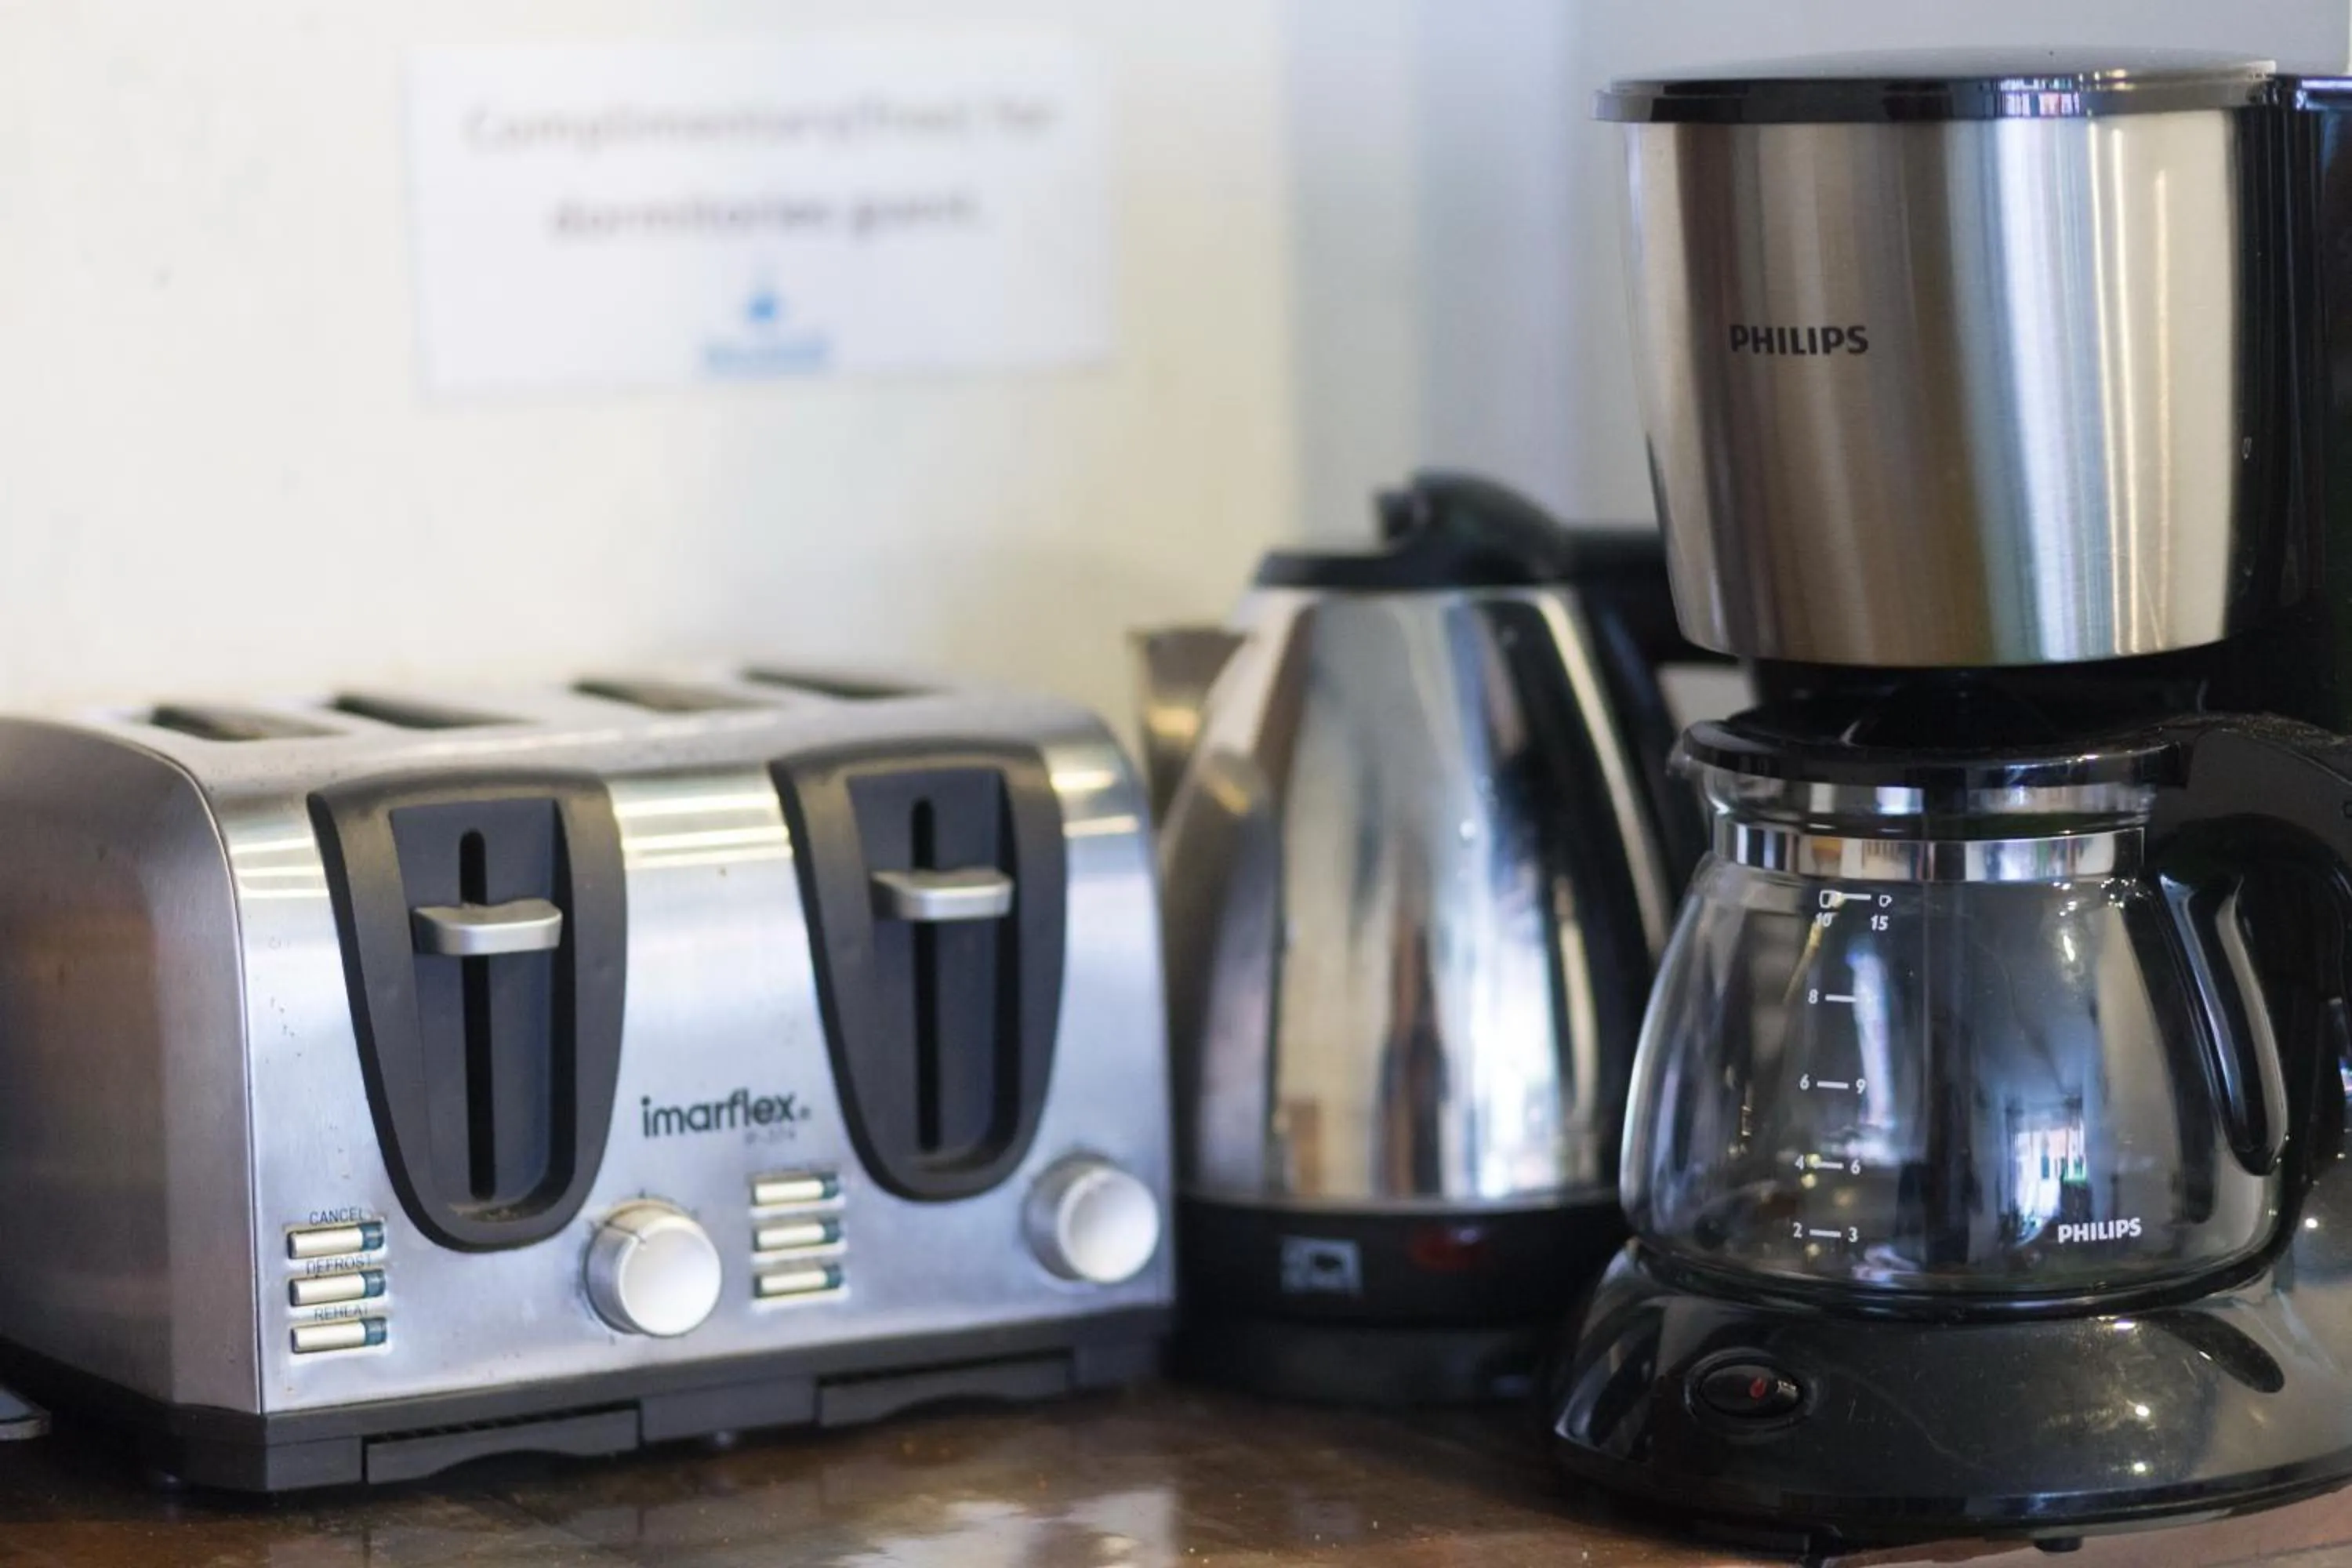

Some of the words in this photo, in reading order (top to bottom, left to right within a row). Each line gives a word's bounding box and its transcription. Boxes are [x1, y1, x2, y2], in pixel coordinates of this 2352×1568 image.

[1729, 324, 1869, 355] PHILIPS
[1871, 915, 1889, 931] 15
[1808, 989, 1818, 1004] 8
[1800, 1074, 1809, 1091] 6
[1856, 1079, 1866, 1094] 9
[1795, 1155, 1805, 1170] 4
[1850, 1159, 1861, 1175] 6
[309, 1207, 366, 1225] CANCEL
[1793, 1222, 1802, 1239] 2
[1848, 1226, 1858, 1243] 3
[2057, 1218, 2142, 1243] PHILIPS
[307, 1254, 371, 1275] DEFROST
[314, 1303, 368, 1321] REHEAT
